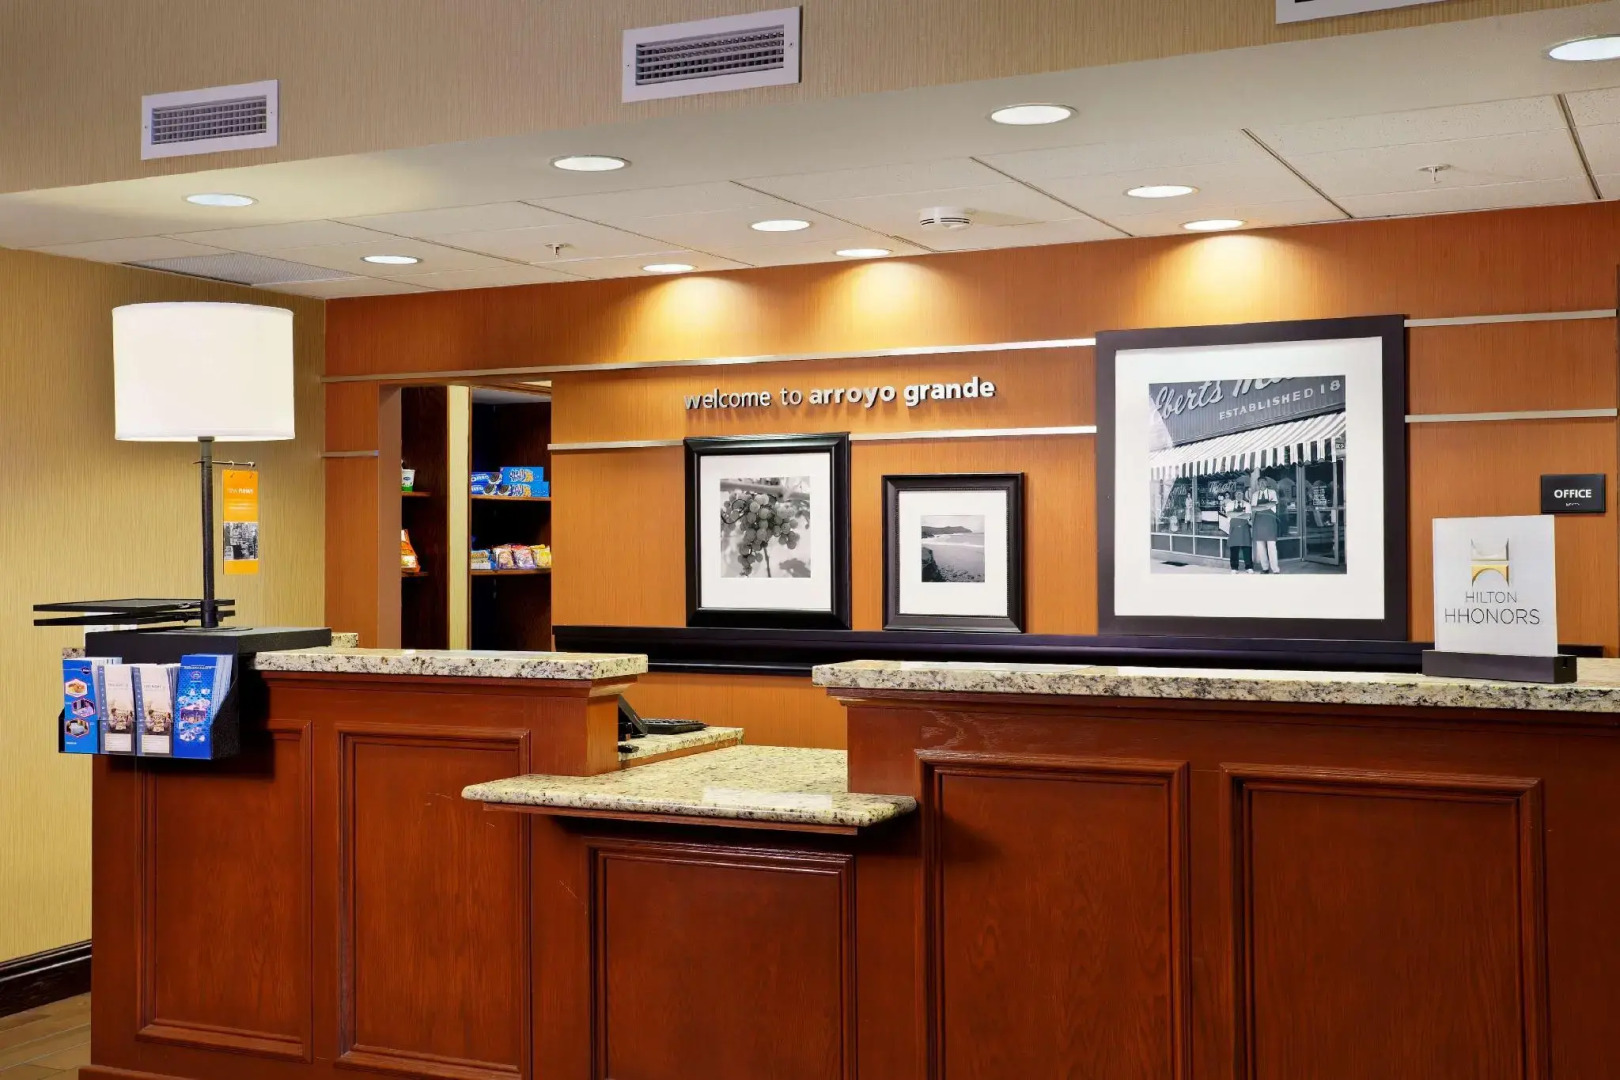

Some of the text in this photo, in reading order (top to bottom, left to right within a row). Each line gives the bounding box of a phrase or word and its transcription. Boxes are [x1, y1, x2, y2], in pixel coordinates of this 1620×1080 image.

[684, 376, 996, 410] welcome to arroyo grande
[1219, 388, 1314, 420] ESTABLISHED
[1553, 489, 1592, 499] OFFICE
[1465, 591, 1517, 604] HILTON
[1444, 608, 1541, 625] HHONORS
